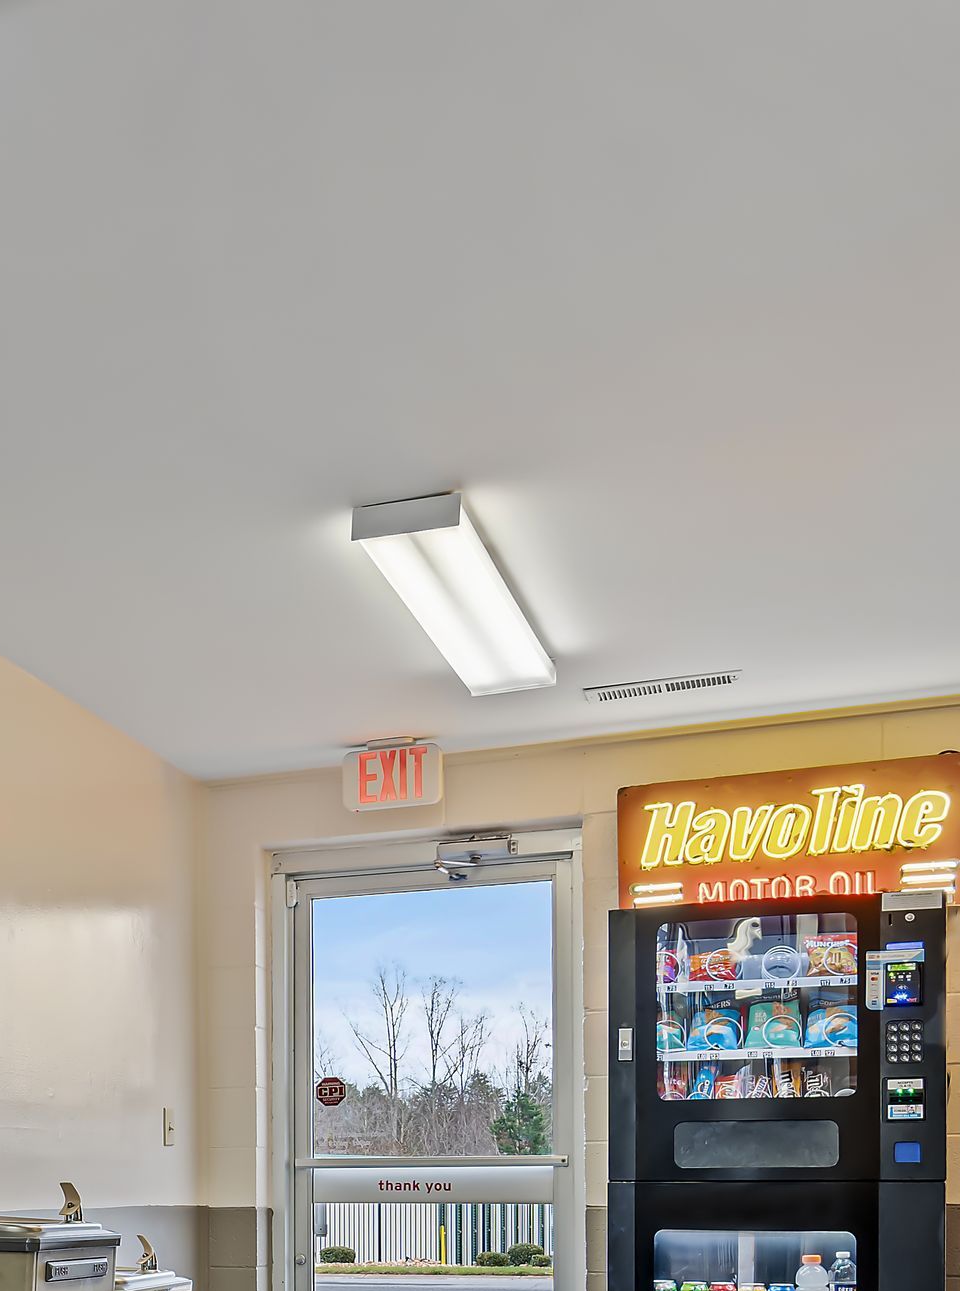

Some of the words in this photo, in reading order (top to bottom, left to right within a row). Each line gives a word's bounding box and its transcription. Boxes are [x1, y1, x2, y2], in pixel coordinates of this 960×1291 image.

[358, 747, 428, 803] EXIT
[640, 783, 952, 870] Havoline
[697, 874, 817, 904] MOTOR
[828, 869, 876, 896] OIL
[318, 1086, 344, 1097] CPI
[378, 1179, 420, 1192] thank
[425, 1182, 452, 1194] you
